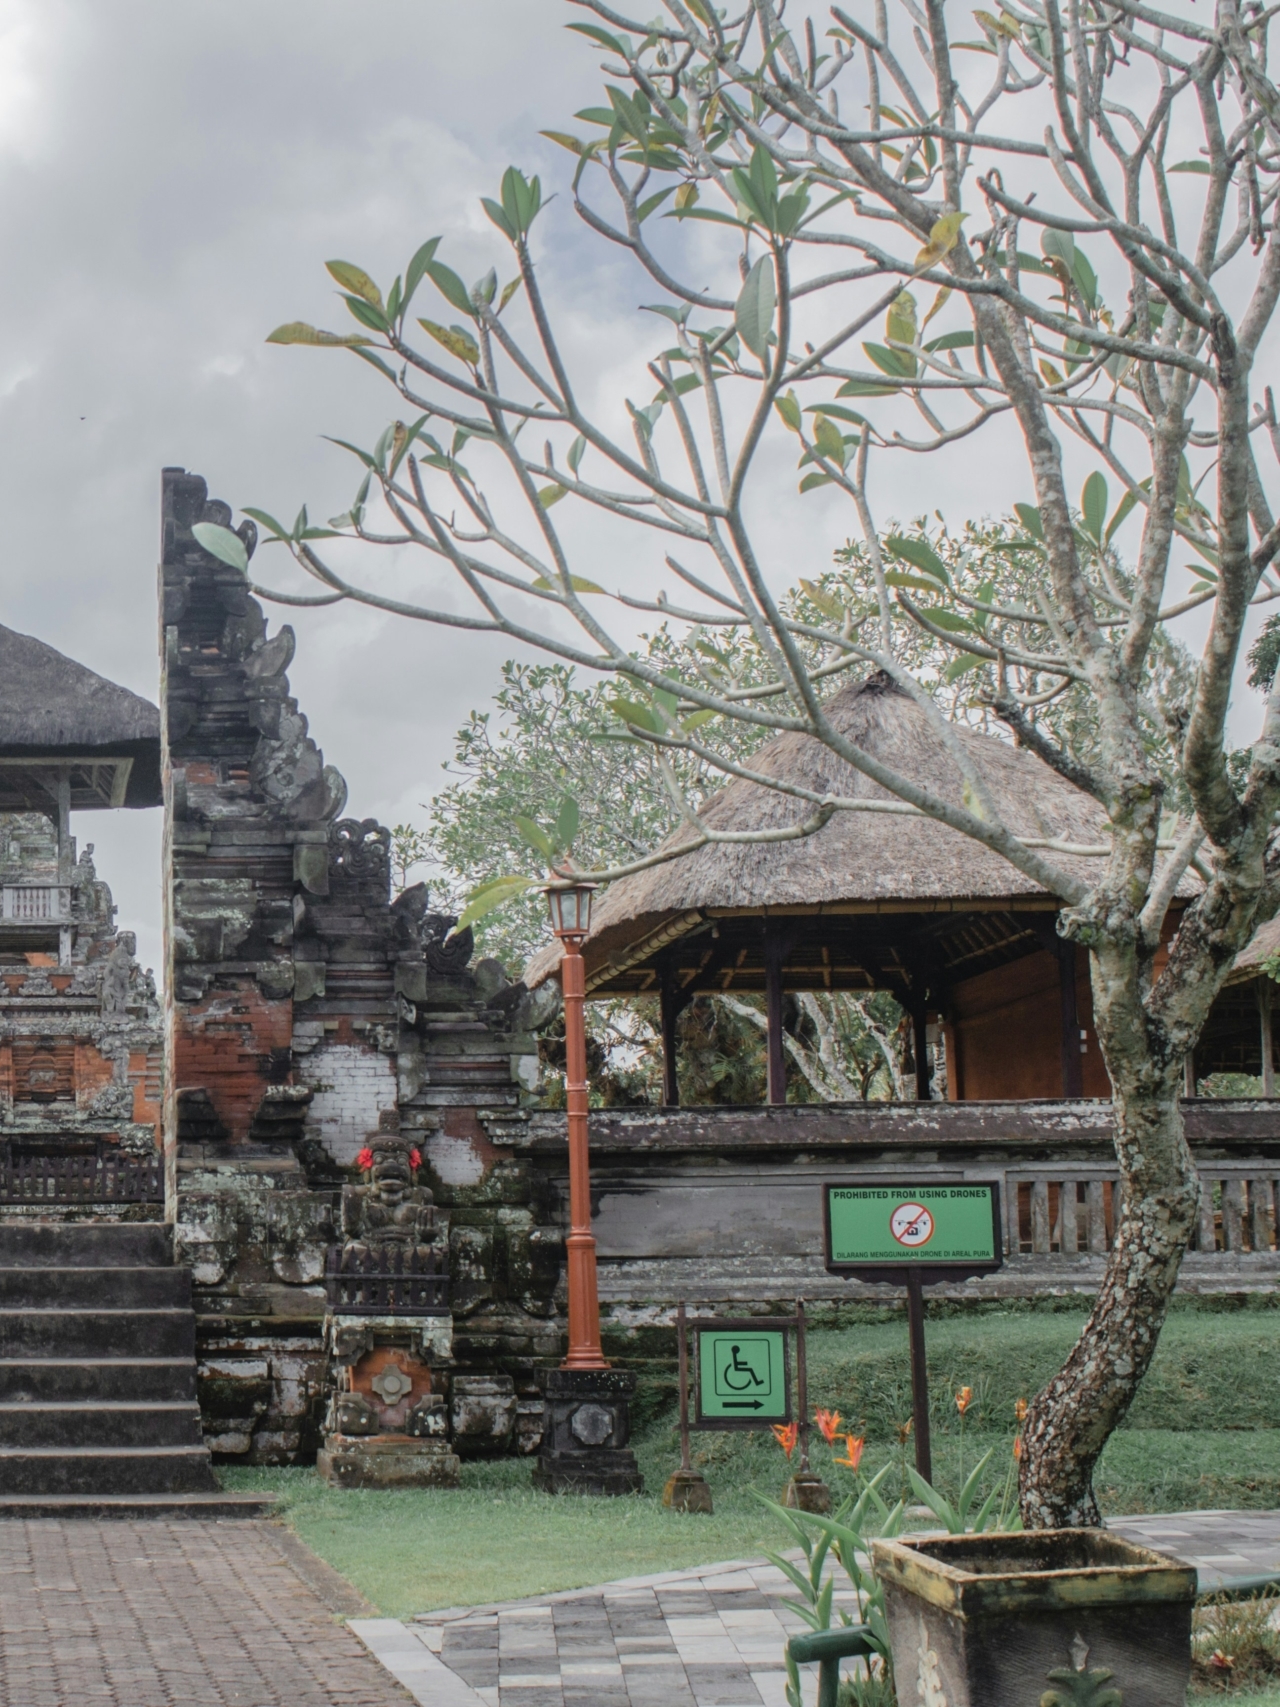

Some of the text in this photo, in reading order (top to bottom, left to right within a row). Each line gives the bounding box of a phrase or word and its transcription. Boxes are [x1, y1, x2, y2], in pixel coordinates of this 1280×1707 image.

[834, 1189, 987, 1199] PROHIBITED FROM USING DRONES
